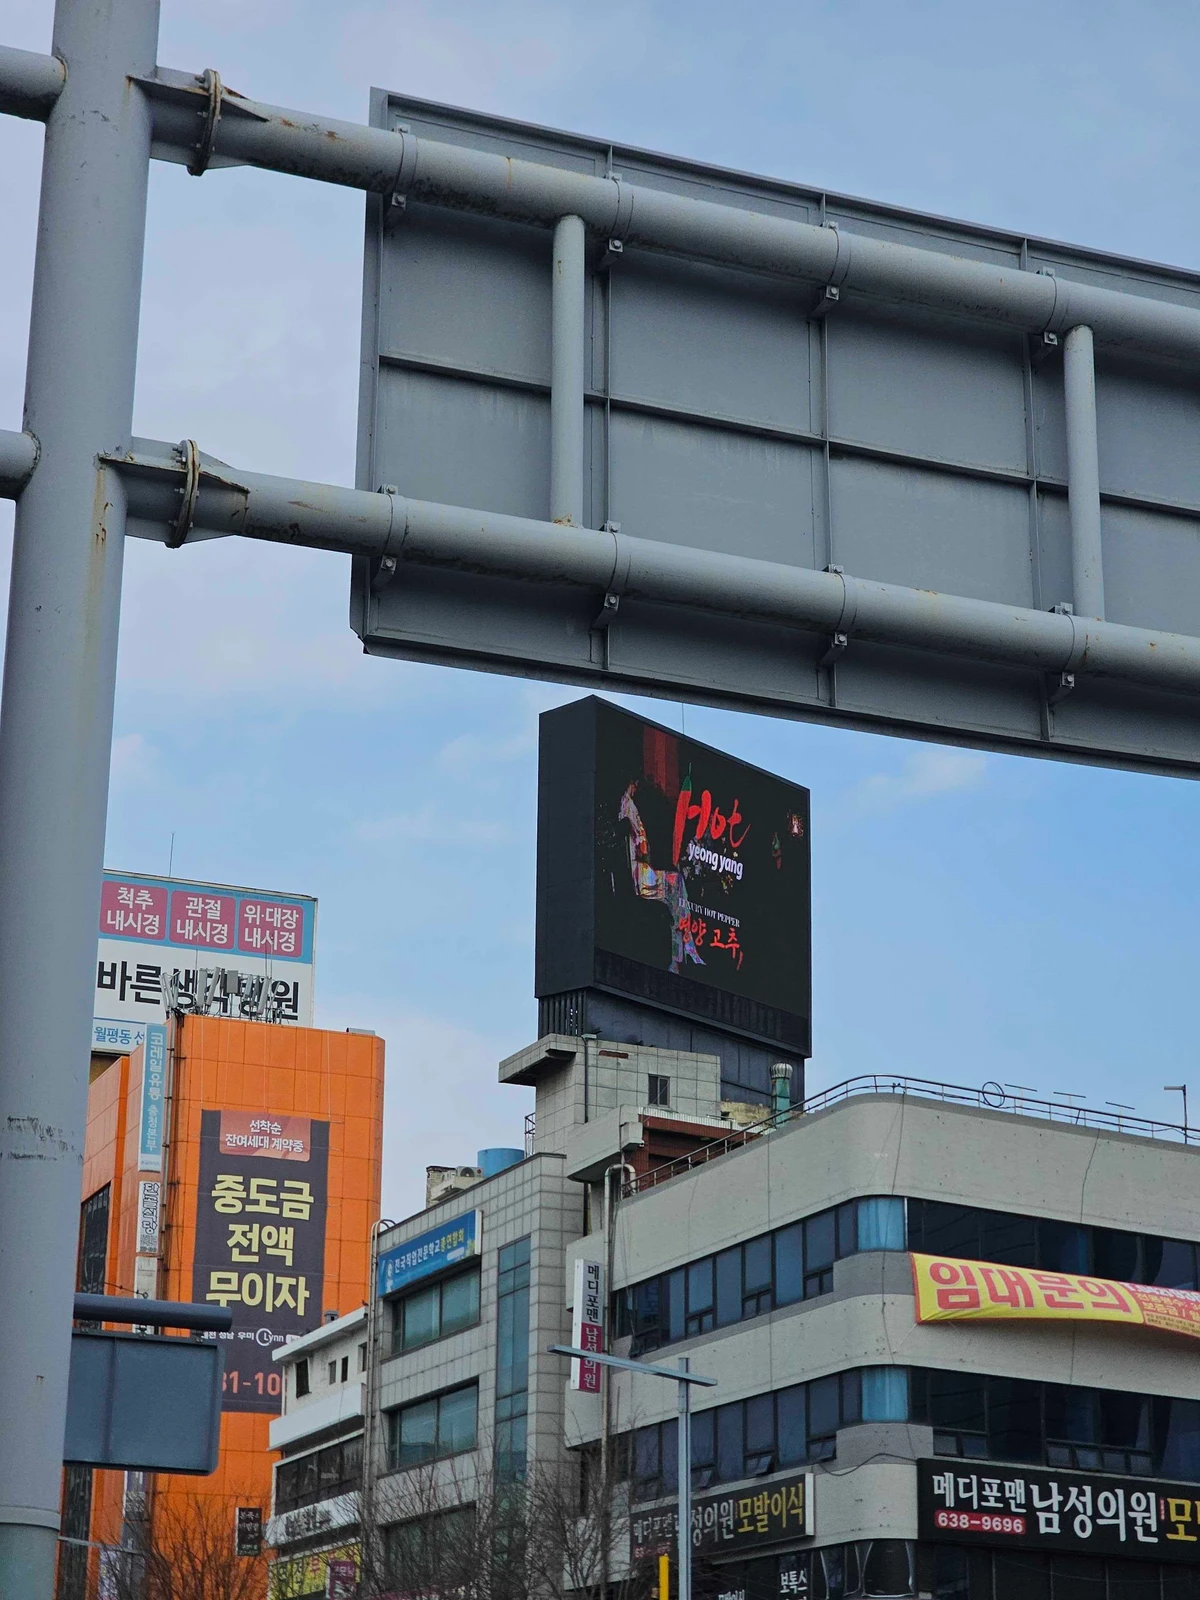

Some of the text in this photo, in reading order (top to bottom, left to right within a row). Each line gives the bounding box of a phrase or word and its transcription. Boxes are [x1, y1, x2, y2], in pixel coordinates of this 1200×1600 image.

[672, 778, 750, 866] Hot
[688, 841, 744, 880] yeong yang
[117, 886, 154, 911] 척추
[185, 896, 222, 920] 관절
[679, 898, 740, 927] LUXURY HOT PEPPER
[106, 909, 160, 936] 내시경
[176, 919, 229, 945] 내시경
[679, 913, 740, 958] 영양 고추
[244, 928, 296, 953] 내시경
[94, 1025, 133, 1046] 월평동
[249, 1119, 282, 1136] 선착순
[225, 1133, 304, 1153] 잔여세대 계약중
[211, 1174, 315, 1221] 중도금
[226, 1223, 295, 1267] 전액
[206, 1271, 310, 1317] 무이자
[587, 1264, 600, 1324] 메디포맨
[929, 1261, 1132, 1314] 임대문의
[237, 1331, 255, 1340] 우미
[737, 1482, 804, 1534] 모발이식
[932, 1472, 1027, 1513] 메디포맨
[1029, 1482, 1159, 1544] 남성의원
[1165, 1497, 1200, 1542] 모
[938, 1513, 1024, 1533] 638-9696
[780, 1568, 807, 1594] 보톡스
